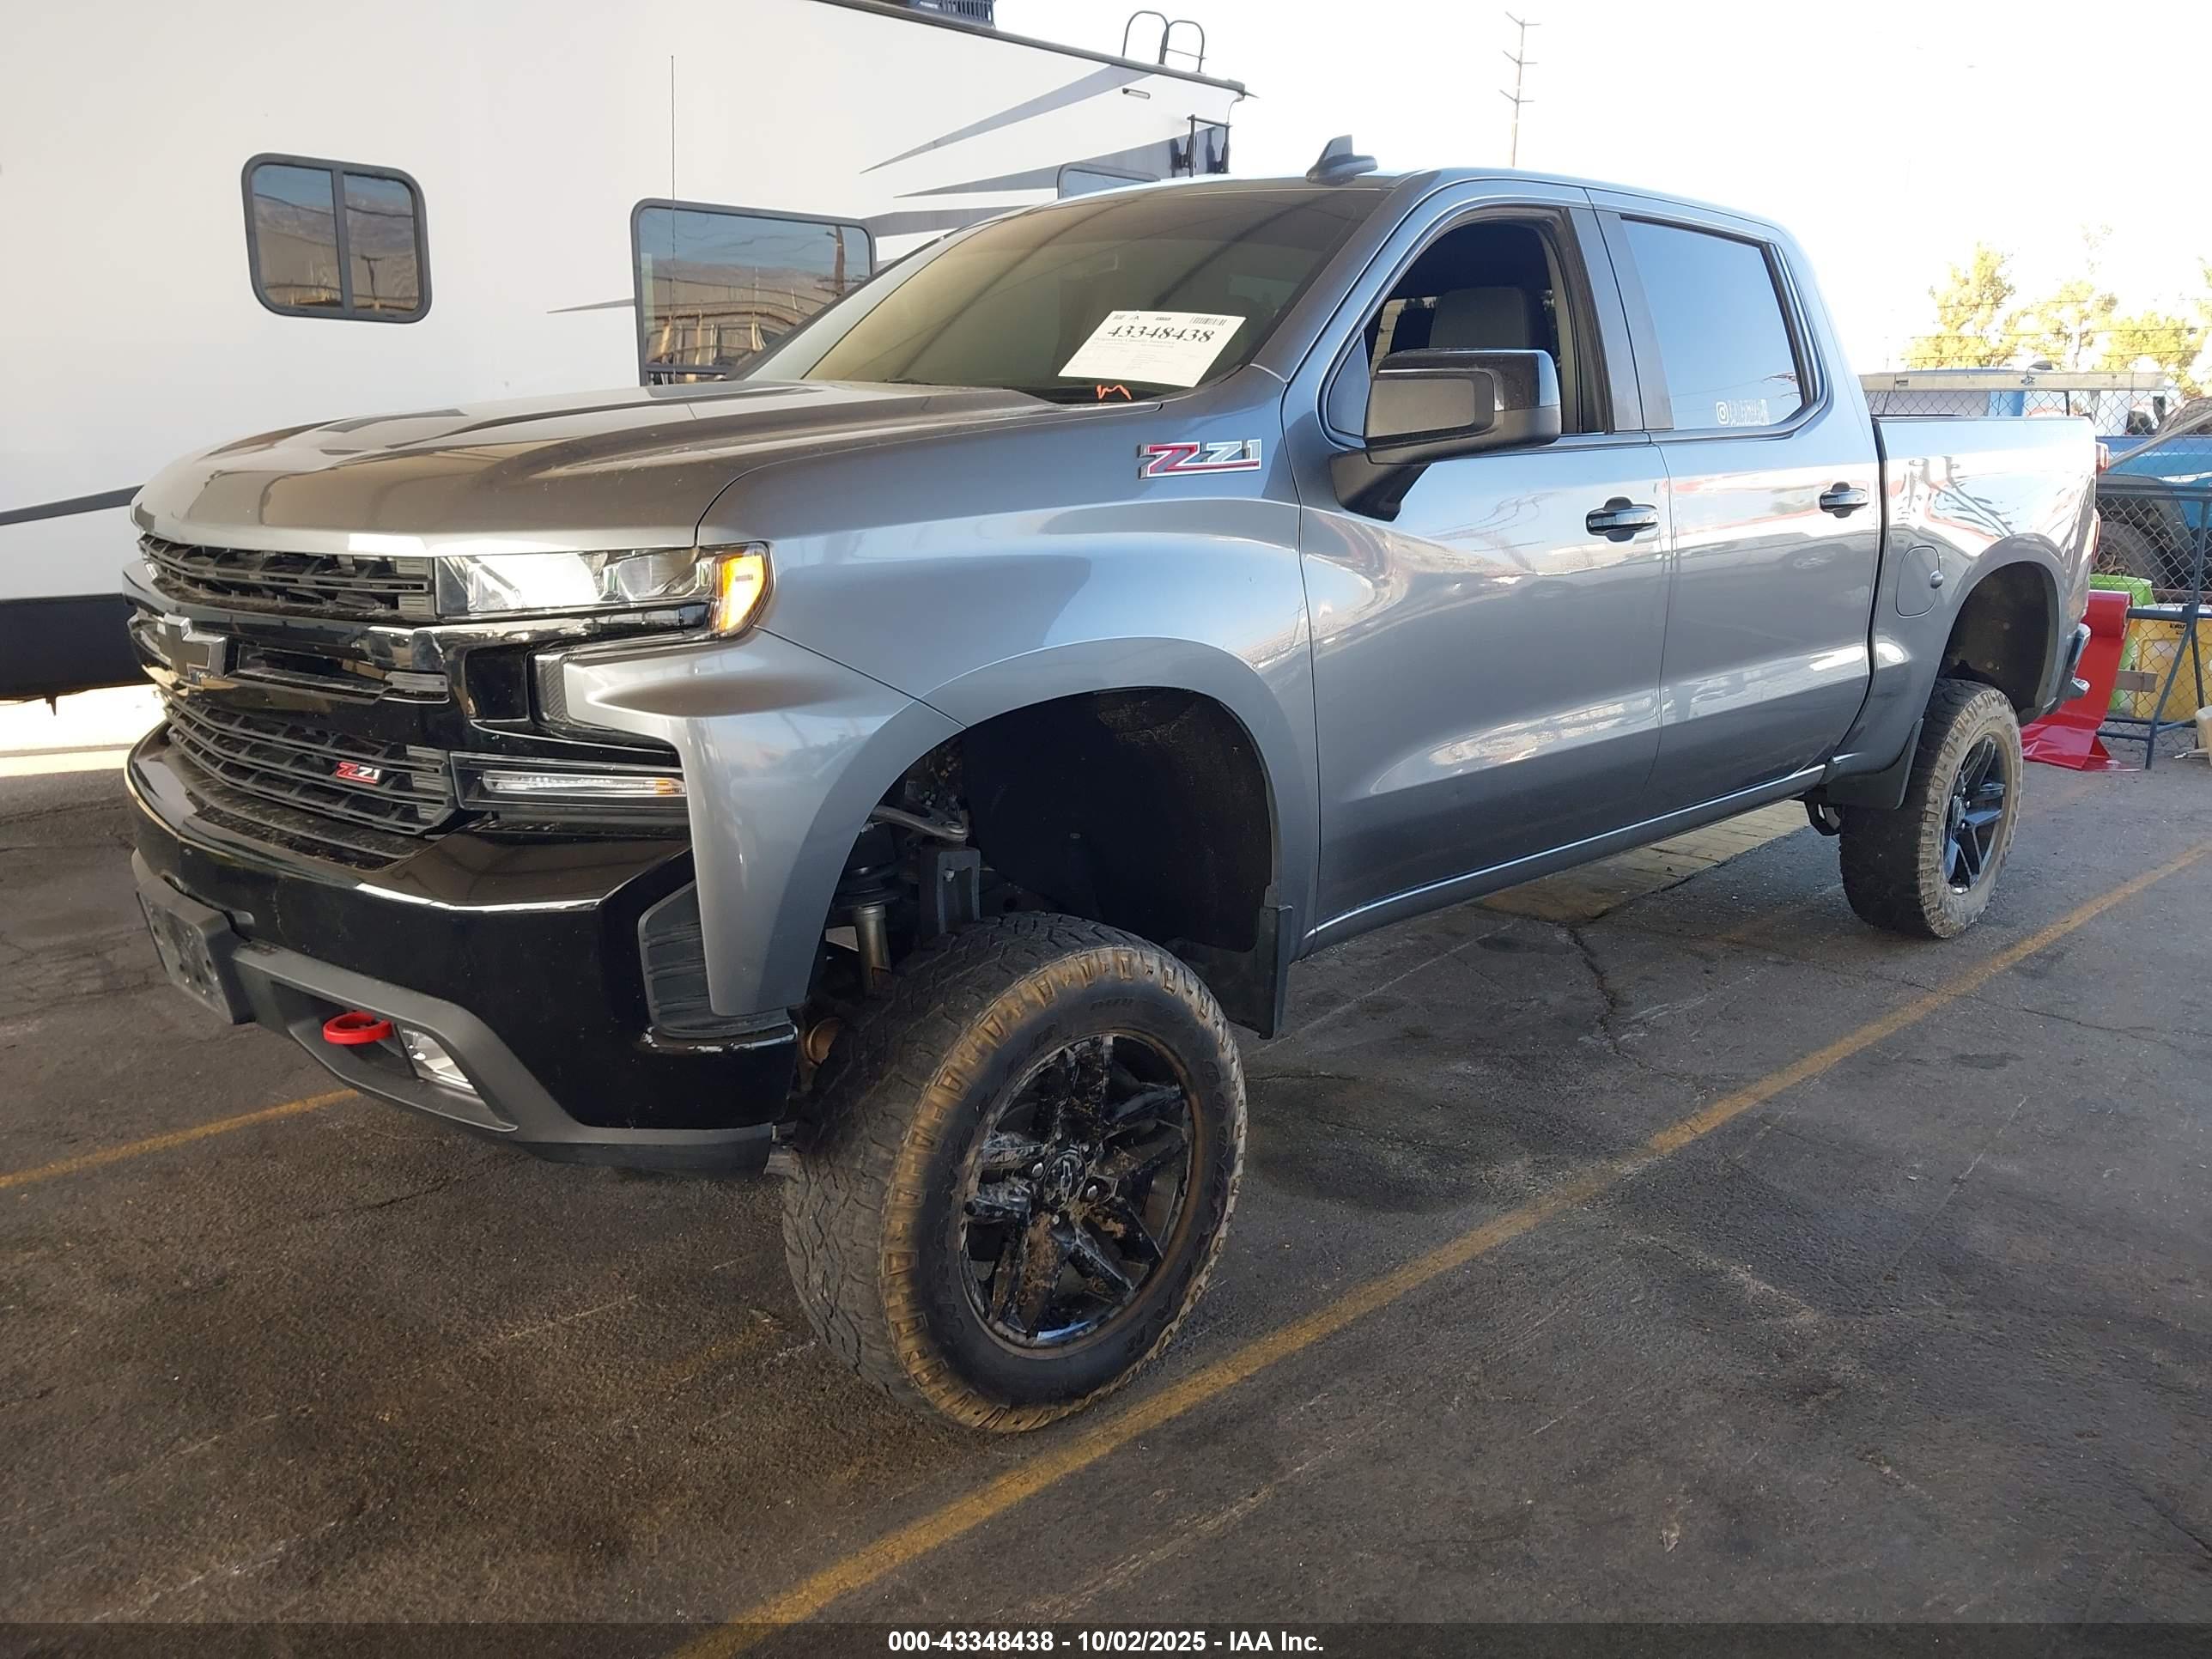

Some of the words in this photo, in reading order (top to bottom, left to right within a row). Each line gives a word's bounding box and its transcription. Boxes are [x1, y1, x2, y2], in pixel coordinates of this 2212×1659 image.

[1107, 325, 1215, 343] 43348438
[1140, 439, 1262, 477] Z71
[336, 762, 380, 783] Z71
